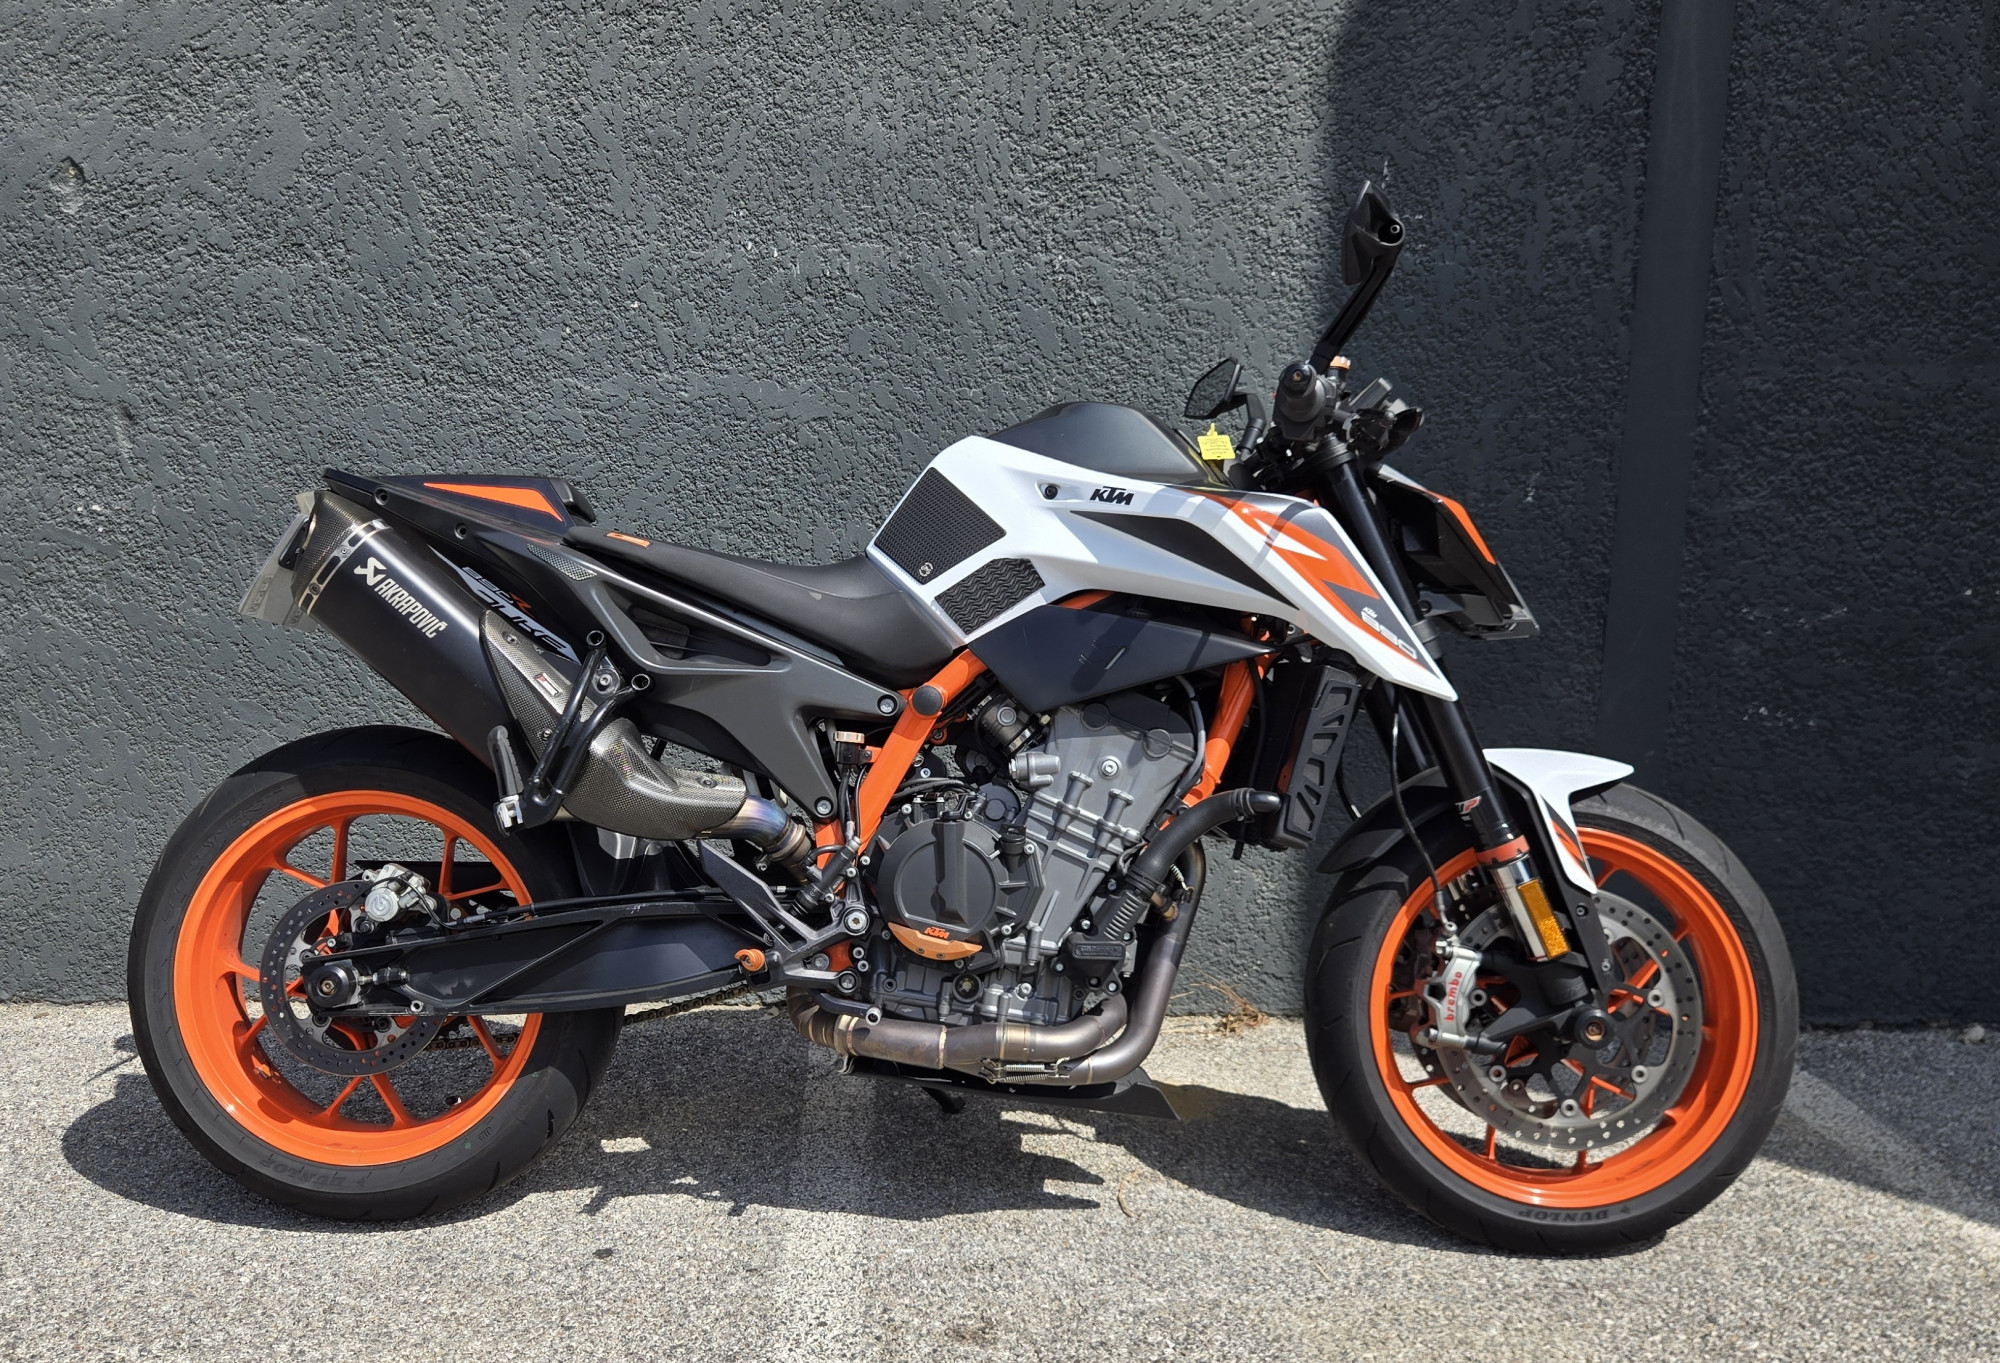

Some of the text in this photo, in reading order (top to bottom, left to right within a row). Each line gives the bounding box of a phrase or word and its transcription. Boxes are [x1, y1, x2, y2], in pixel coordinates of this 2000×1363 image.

[1089, 485, 1135, 506] KTM
[1361, 610, 1418, 660] 890
[923, 926, 950, 940] KTM
[1444, 971, 1463, 1021] brembo
[1517, 1208, 1610, 1223] DUNLOP
